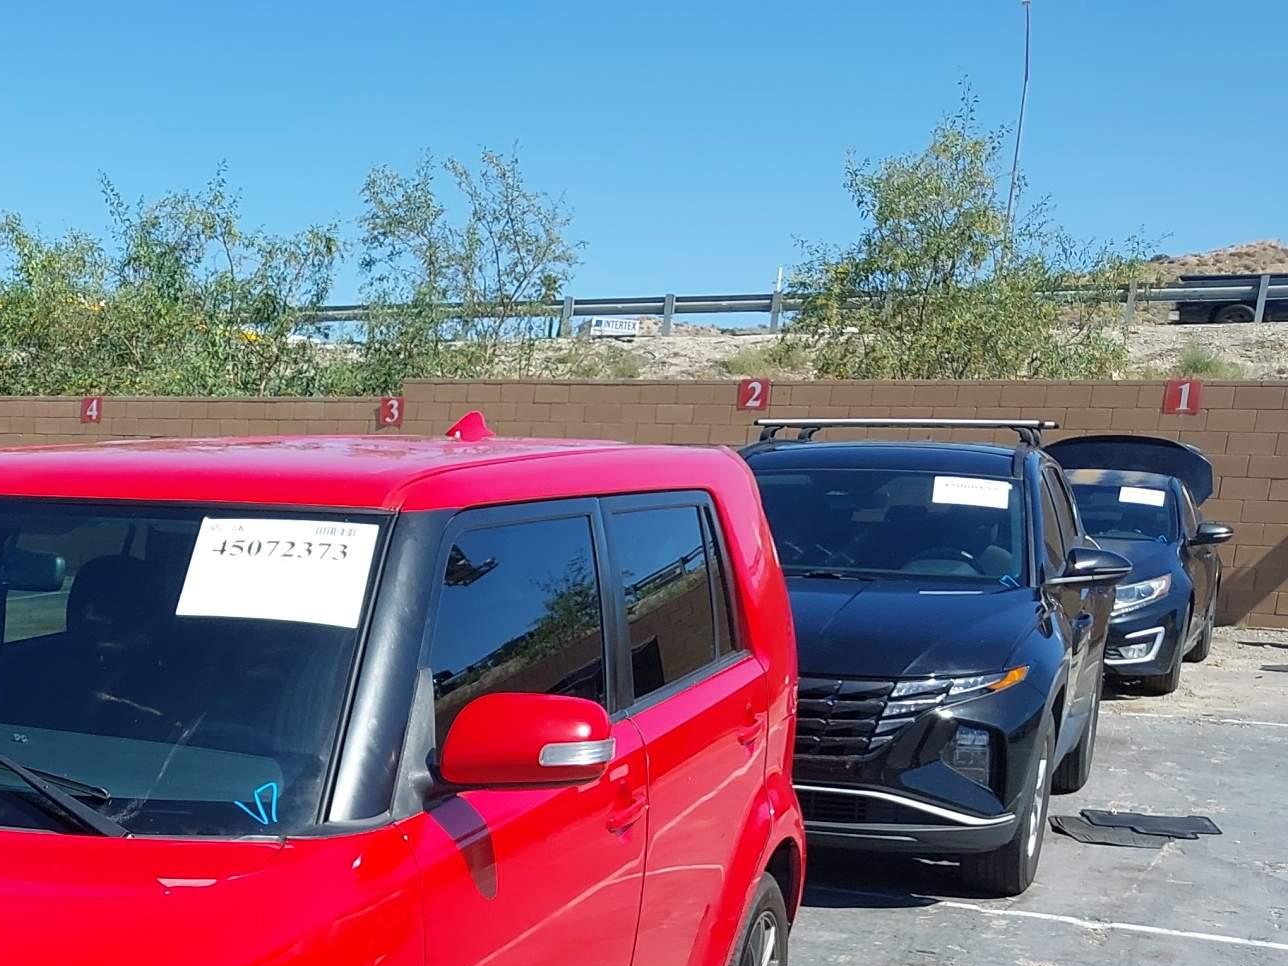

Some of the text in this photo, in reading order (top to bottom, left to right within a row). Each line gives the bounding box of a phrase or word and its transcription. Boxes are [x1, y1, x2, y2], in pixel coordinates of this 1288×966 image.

[603, 320, 636, 330] INTERTEX
[745, 381, 762, 407] 2
[1175, 383, 1191, 410] 1
[86, 399, 98, 420] 4
[385, 399, 399, 422] 3
[212, 539, 348, 561] 45072373
